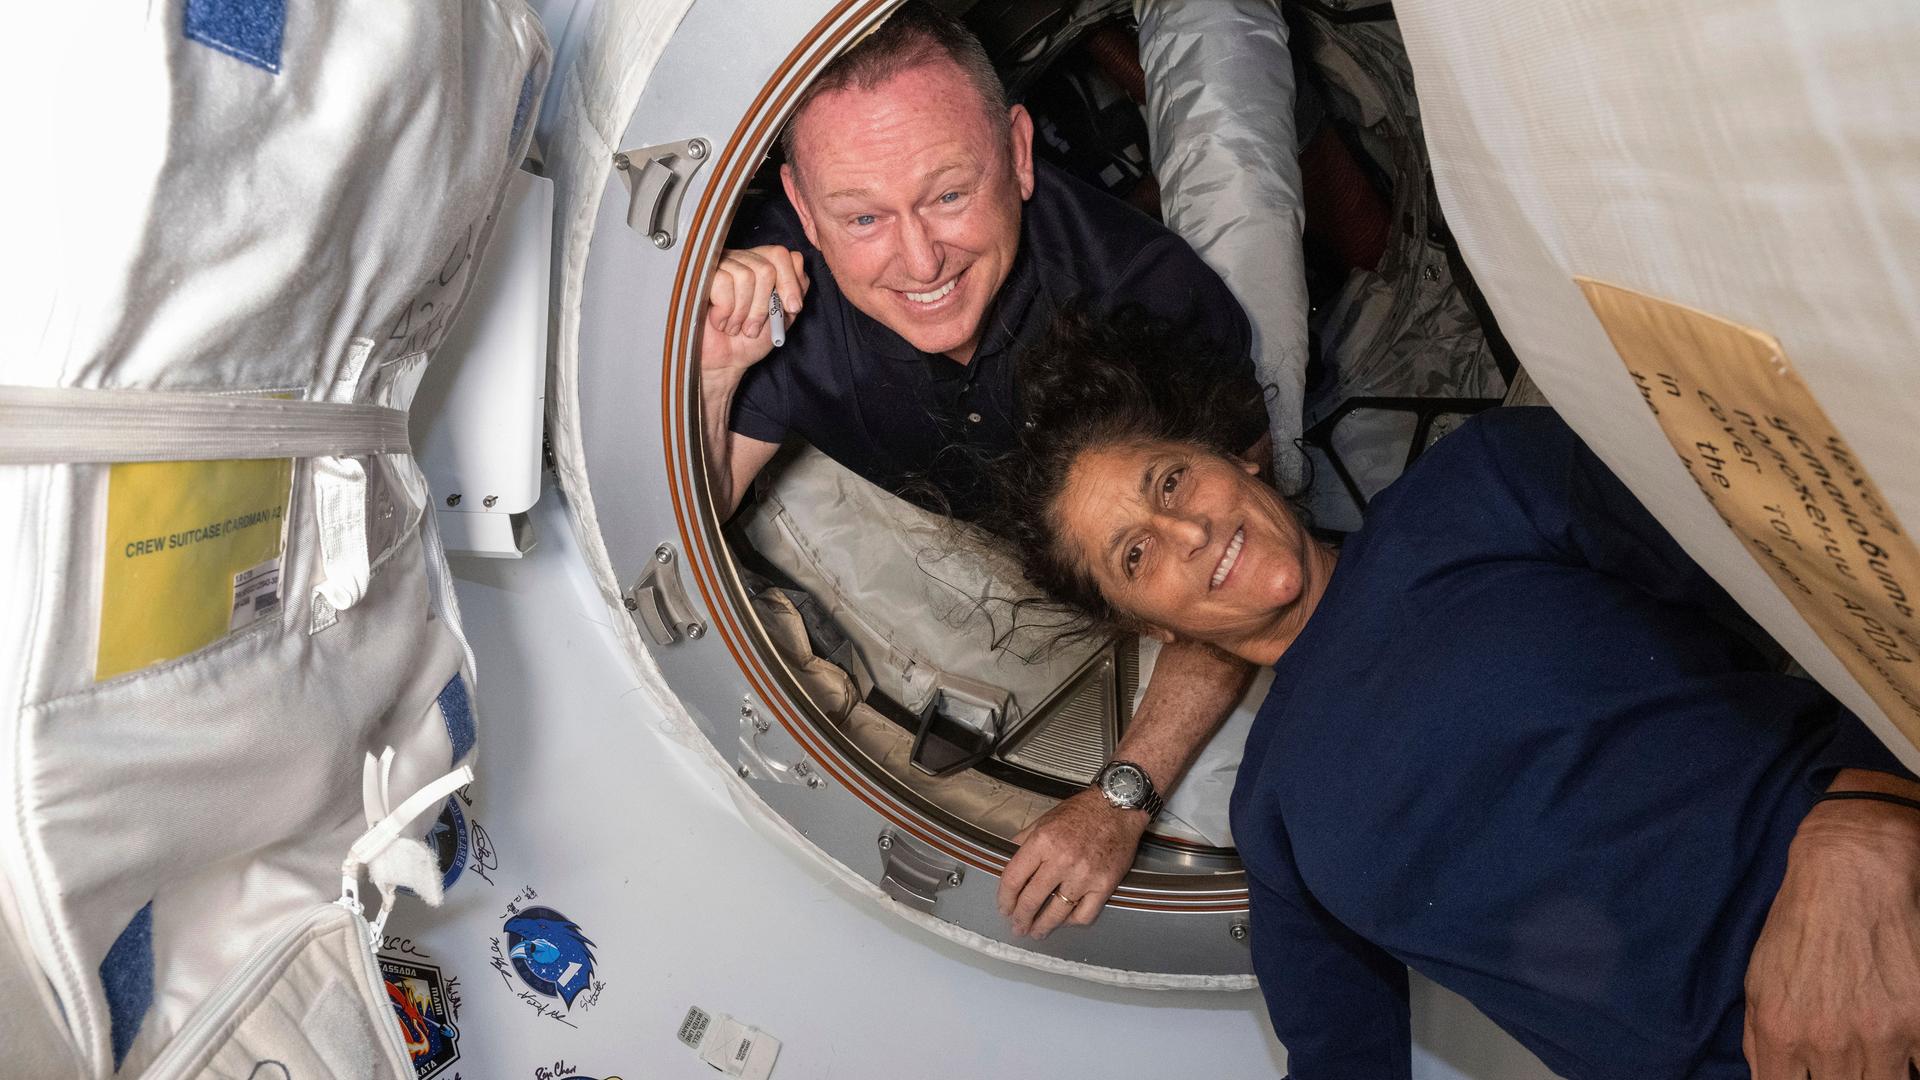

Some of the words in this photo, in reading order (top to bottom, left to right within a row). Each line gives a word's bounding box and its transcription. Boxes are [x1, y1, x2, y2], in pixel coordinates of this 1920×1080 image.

[1656, 372, 1682, 397] in
[1696, 441, 1730, 489] the
[1697, 390, 1762, 474] cover
[125, 536, 166, 558] CREW
[169, 523, 221, 549] SUITCASE
[456, 828, 467, 868] ФЕДЯЕВ
[381, 963, 417, 977] ASSADA
